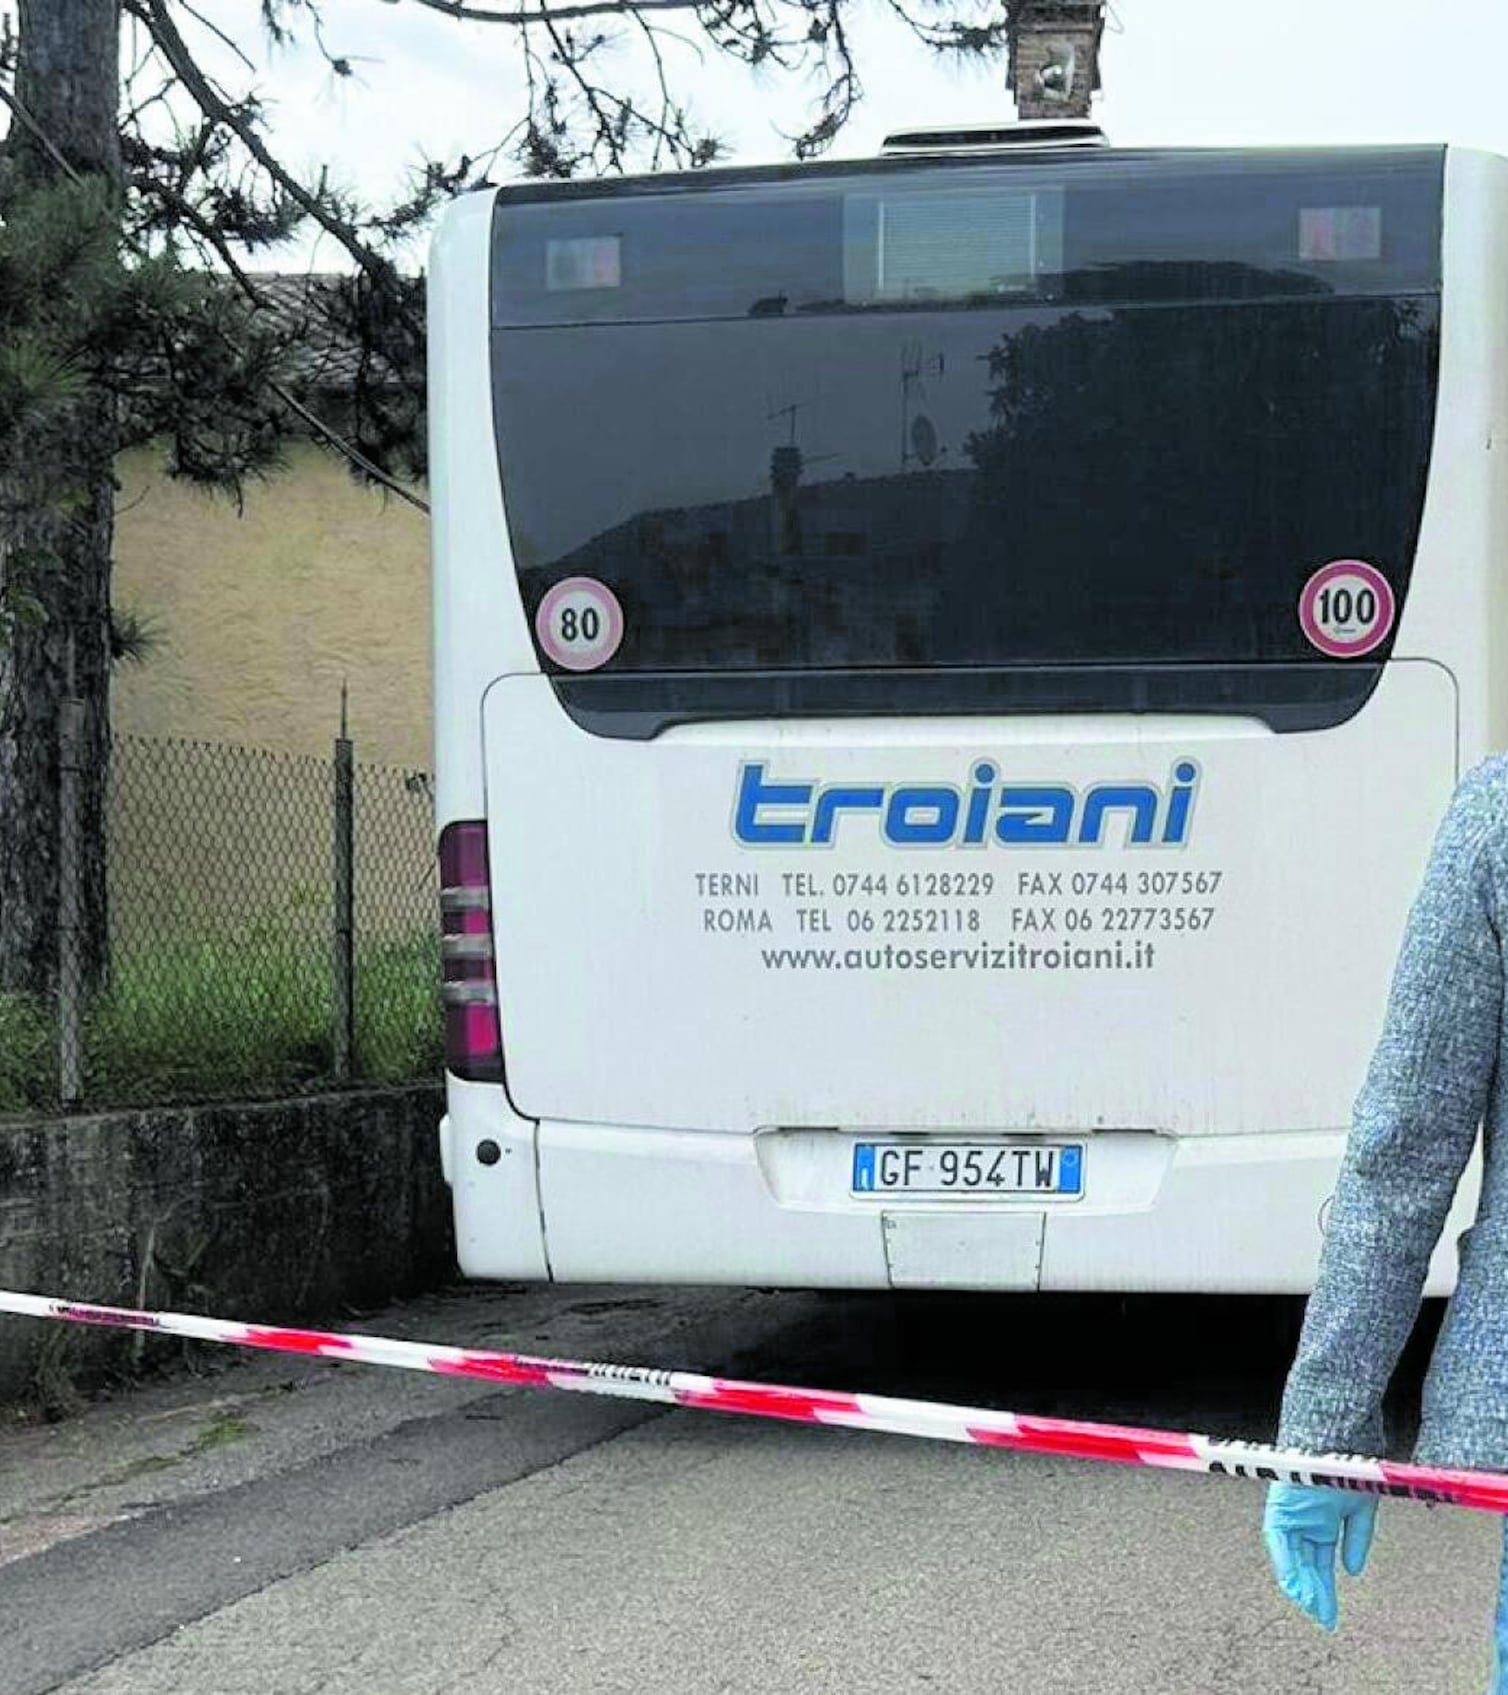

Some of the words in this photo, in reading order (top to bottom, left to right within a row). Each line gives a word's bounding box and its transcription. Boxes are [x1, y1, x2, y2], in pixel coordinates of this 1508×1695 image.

[1319, 588, 1375, 625] 100
[561, 607, 599, 642] 80
[731, 756, 1202, 850] troiani
[695, 873, 759, 897] TERNI
[782, 873, 824, 897] TEL.
[832, 873, 888, 897] 0744
[896, 872, 995, 897] 6128229
[1017, 872, 1063, 896] FAX
[1071, 872, 1128, 896] 0744
[1137, 871, 1223, 896] 307567
[703, 908, 773, 933] ROMA
[796, 908, 832, 933] TEL
[846, 909, 875, 933] 06
[882, 908, 981, 933] 2252118
[1011, 907, 1056, 932] FAX
[1064, 907, 1093, 932] 06
[1101, 906, 1215, 932] 22773567
[760, 939, 1156, 970] www.autoservizitroiani.it
[880, 1149, 923, 1187] GF
[939, 1149, 1054, 1188] 954TW
